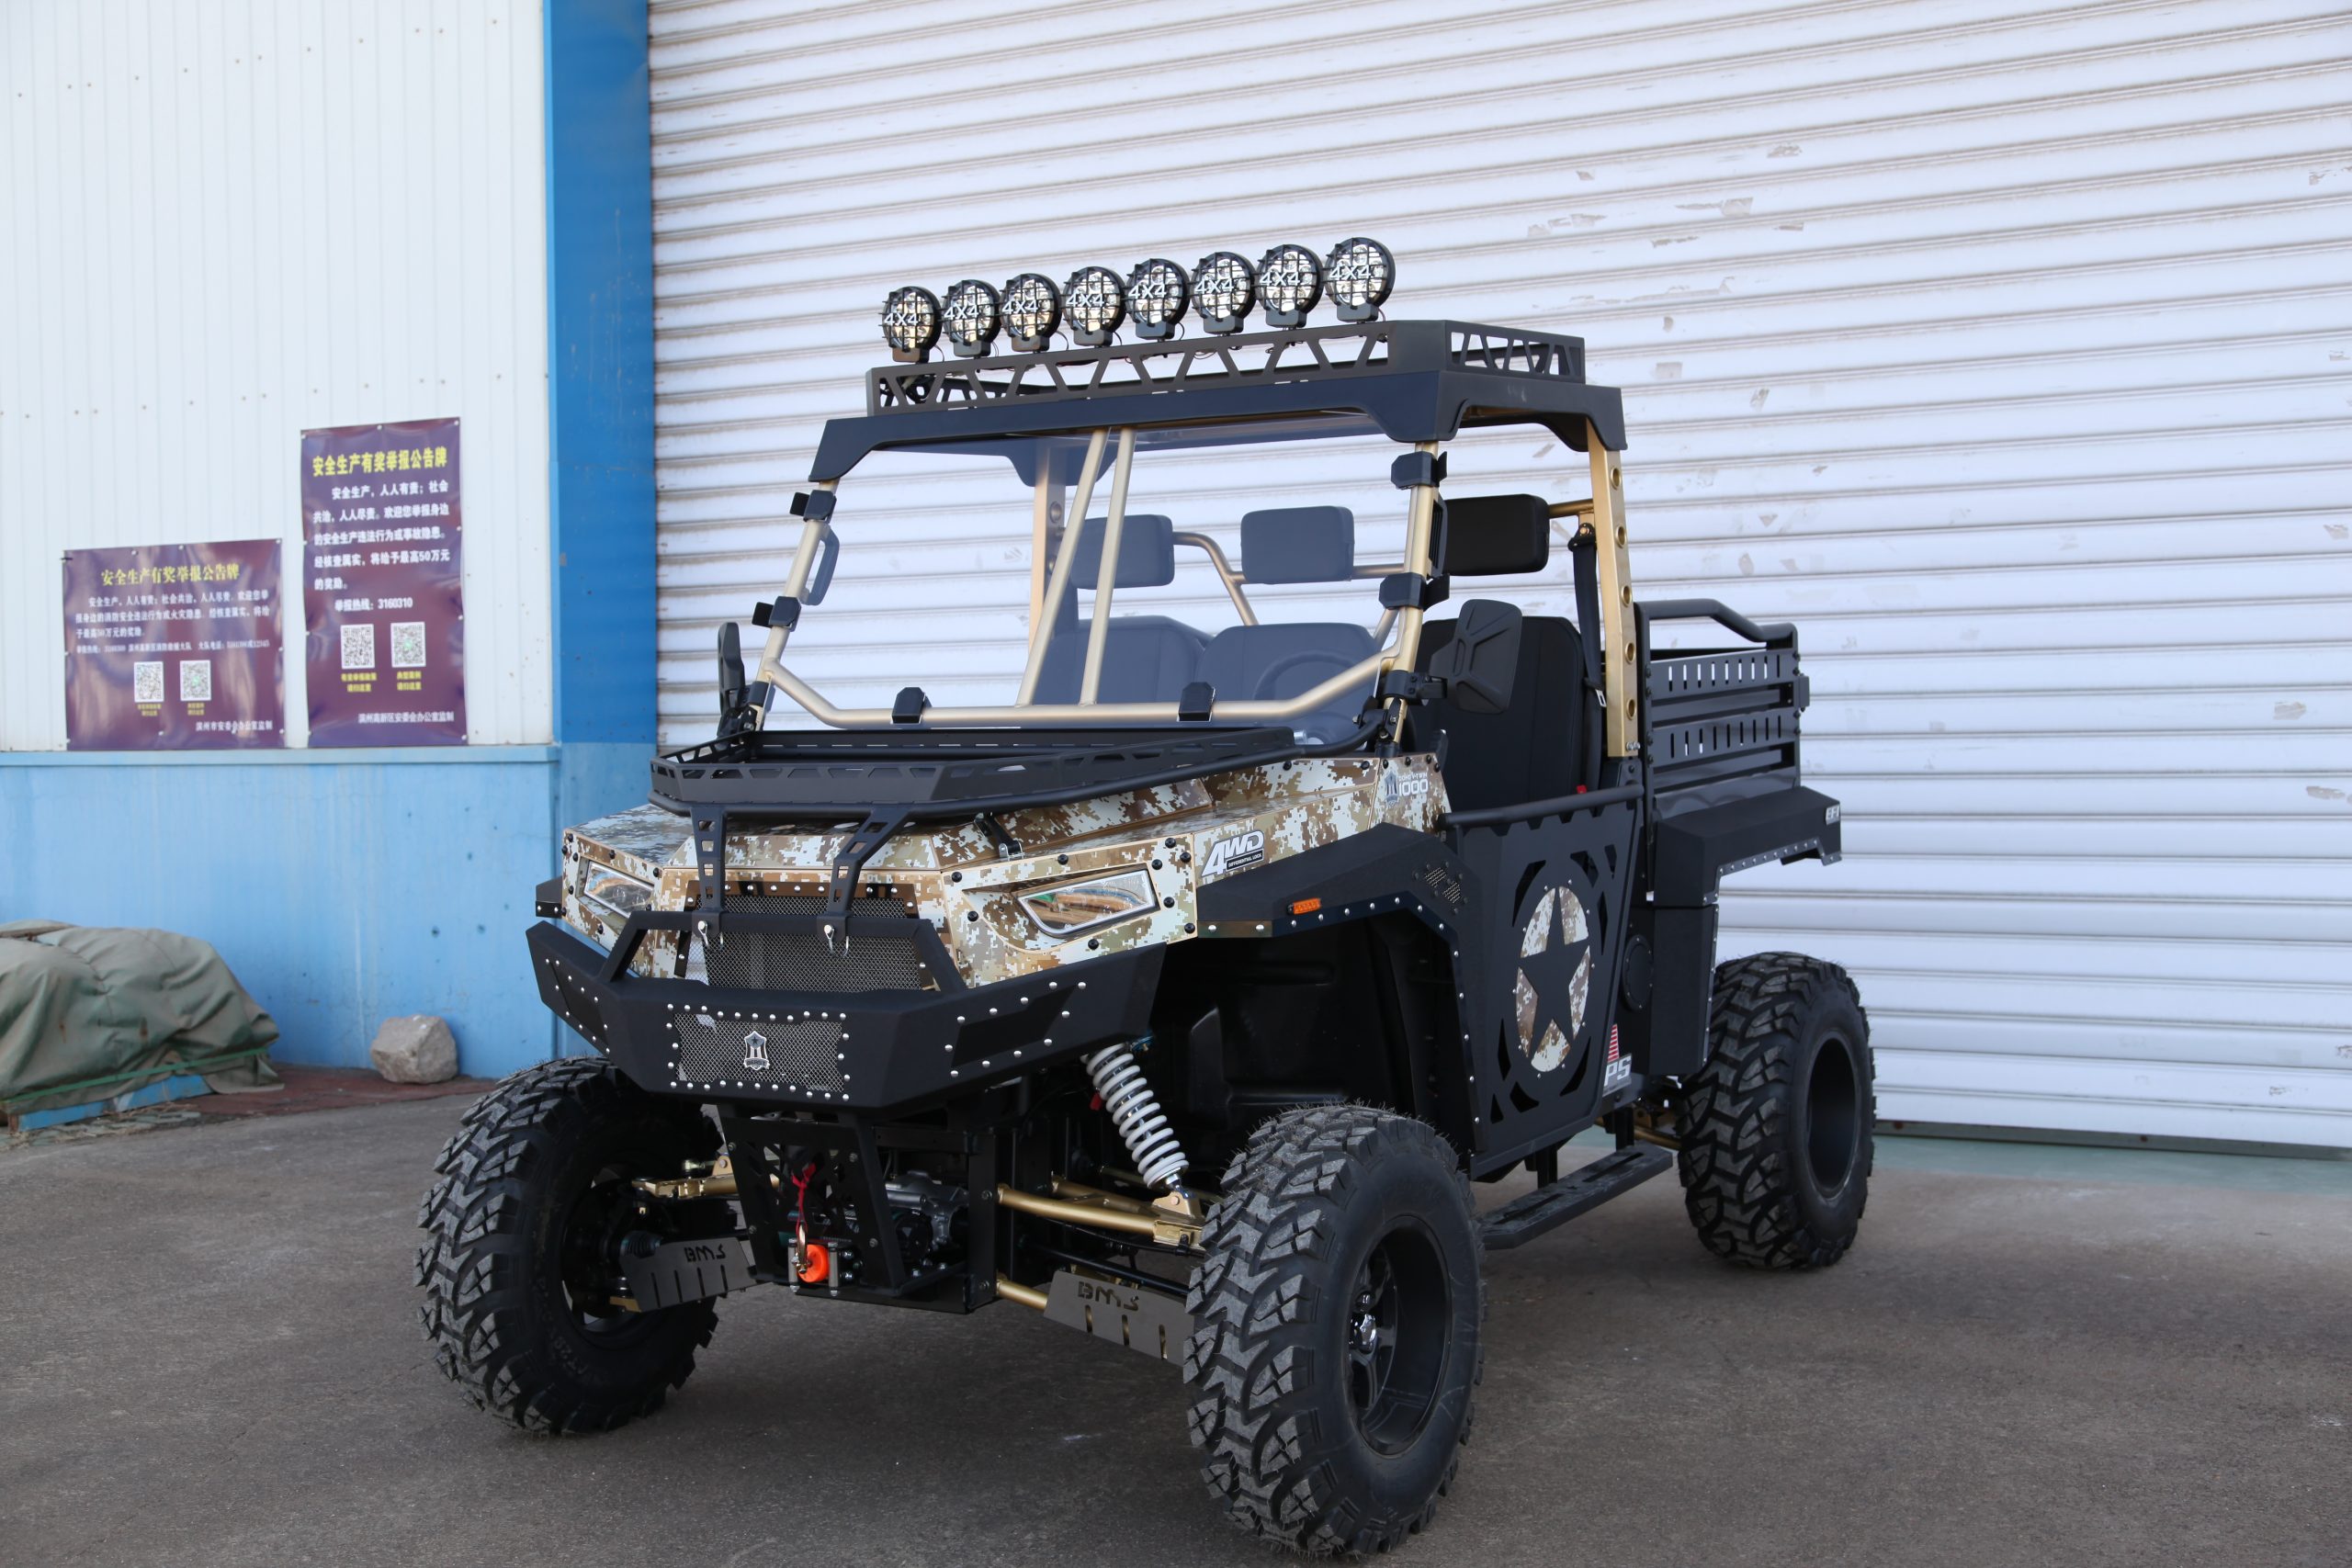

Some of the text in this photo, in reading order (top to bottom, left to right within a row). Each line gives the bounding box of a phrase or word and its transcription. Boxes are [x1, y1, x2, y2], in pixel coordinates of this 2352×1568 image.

[312, 446, 447, 477] 安全生产有奖举报公告牌
[101, 563, 239, 586] 安全生产有奖举报公告牌
[1398, 778, 1428, 796] 1000
[1201, 830, 1264, 875] 4WD
[1228, 852, 1262, 868] DIFFERENTIAL LOCK
[684, 1244, 727, 1263] BMS
[1078, 1280, 1139, 1312] BMS
